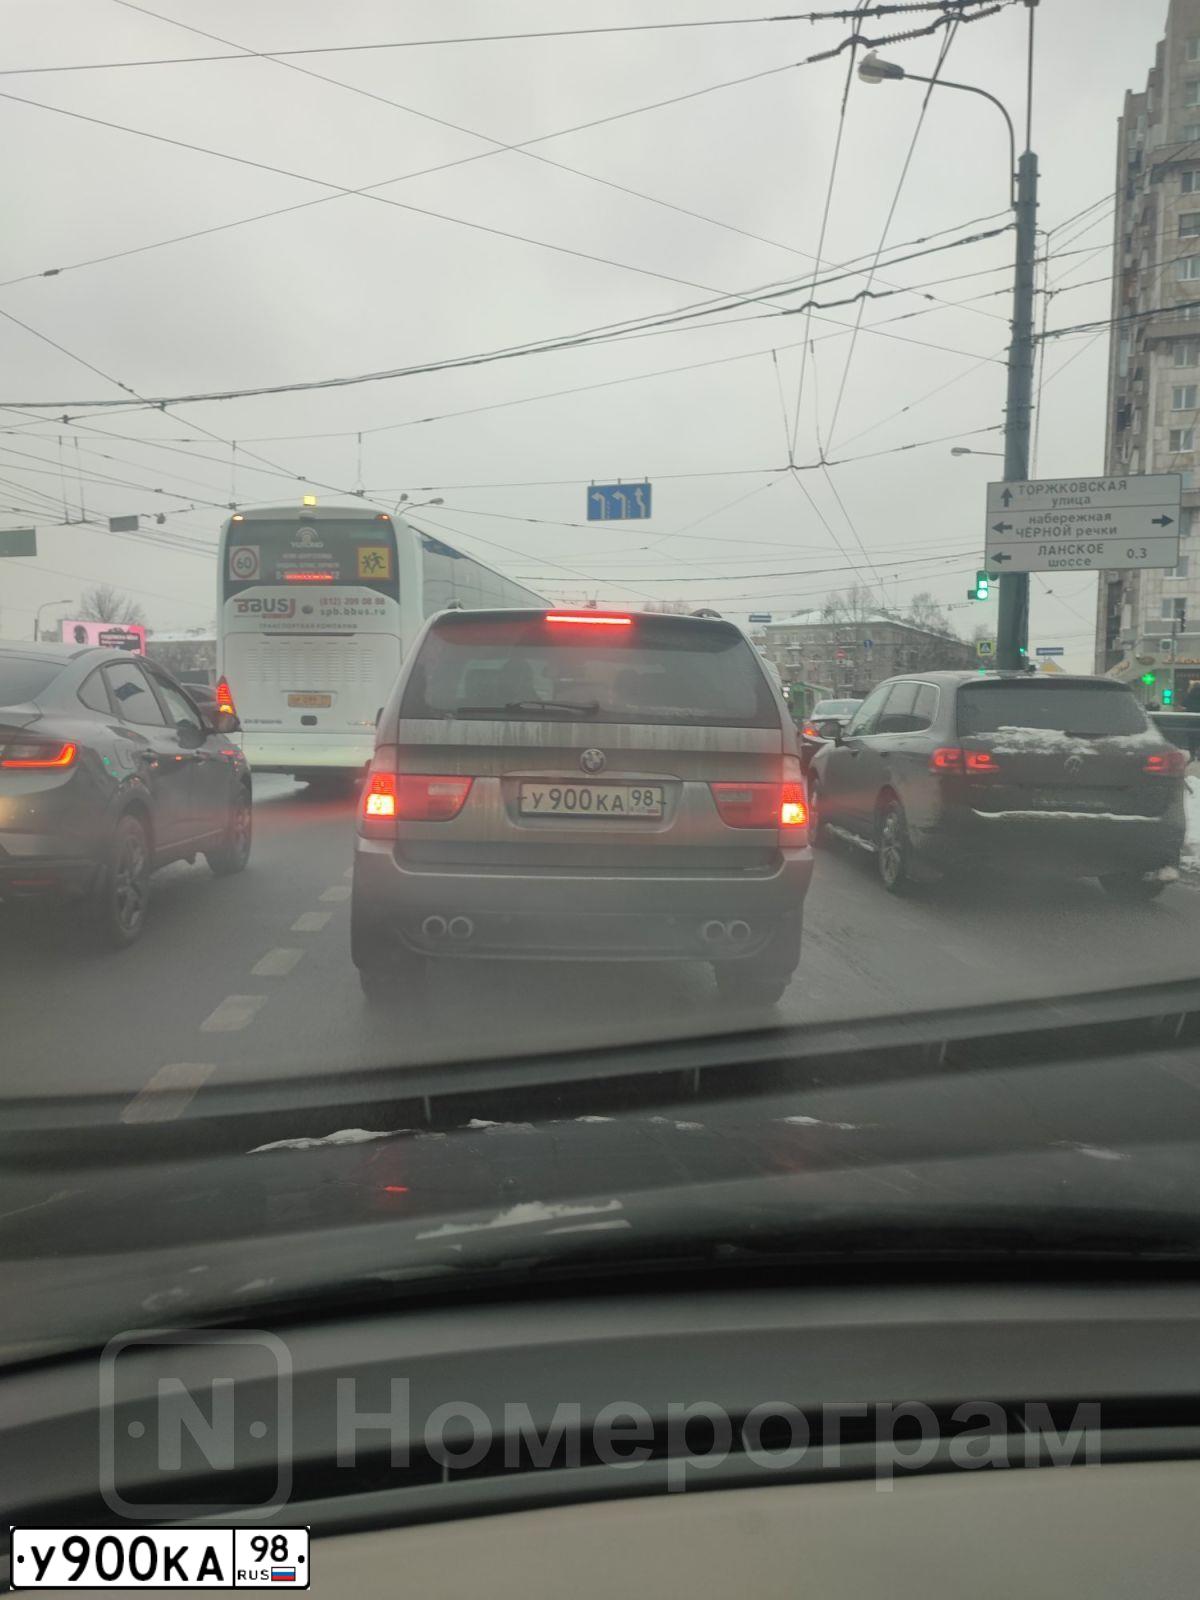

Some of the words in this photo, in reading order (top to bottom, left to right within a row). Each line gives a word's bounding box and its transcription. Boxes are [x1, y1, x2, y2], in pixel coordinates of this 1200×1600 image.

[1017, 480, 1128, 496] ТОРЖКОВСКАЯ
[1051, 496, 1091, 508] улица
[1028, 512, 1112, 525] набережная
[1015, 524, 1072, 539] ЧЕРНОЙ
[1076, 526, 1118, 537] речки
[1037, 543, 1104, 556] ЛАНСКОЕ
[236, 555, 252, 570] 60
[1047, 557, 1092, 568] шоссе
[531, 788, 624, 811] У900КА
[632, 789, 654, 806] 98
